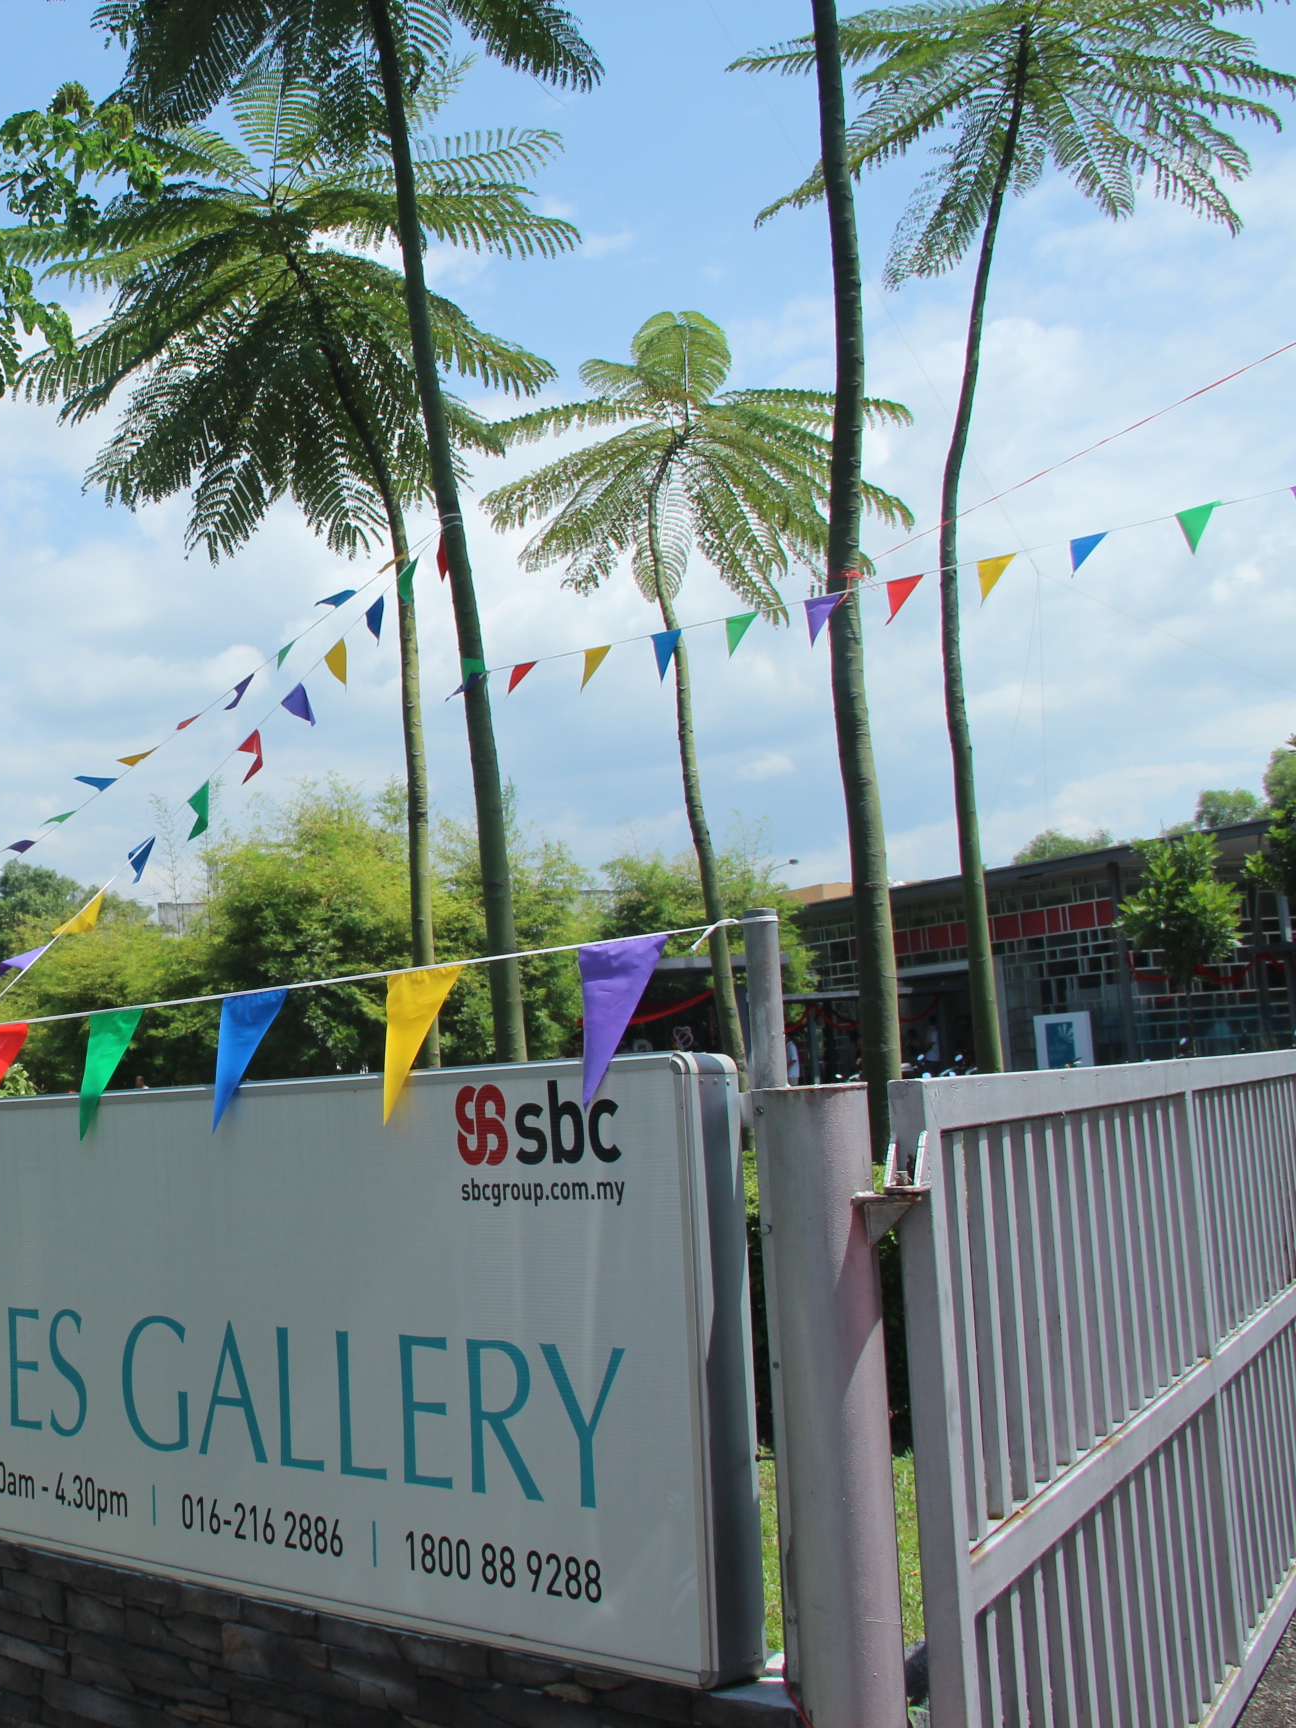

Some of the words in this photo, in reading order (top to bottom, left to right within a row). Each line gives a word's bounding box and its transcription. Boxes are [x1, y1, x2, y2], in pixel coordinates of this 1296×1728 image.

[514, 1080, 622, 1165] sbc
[461, 1177, 625, 1208] sbcgroup.com.my
[121, 1315, 626, 1509] GALLERY
[55, 1472, 128, 1522] 4.30pm
[181, 1493, 276, 1545] 016-216
[283, 1510, 344, 1558] 2886
[405, 1530, 471, 1581] 1800
[481, 1542, 516, 1589] 88
[526, 1549, 602, 1604] 9288
